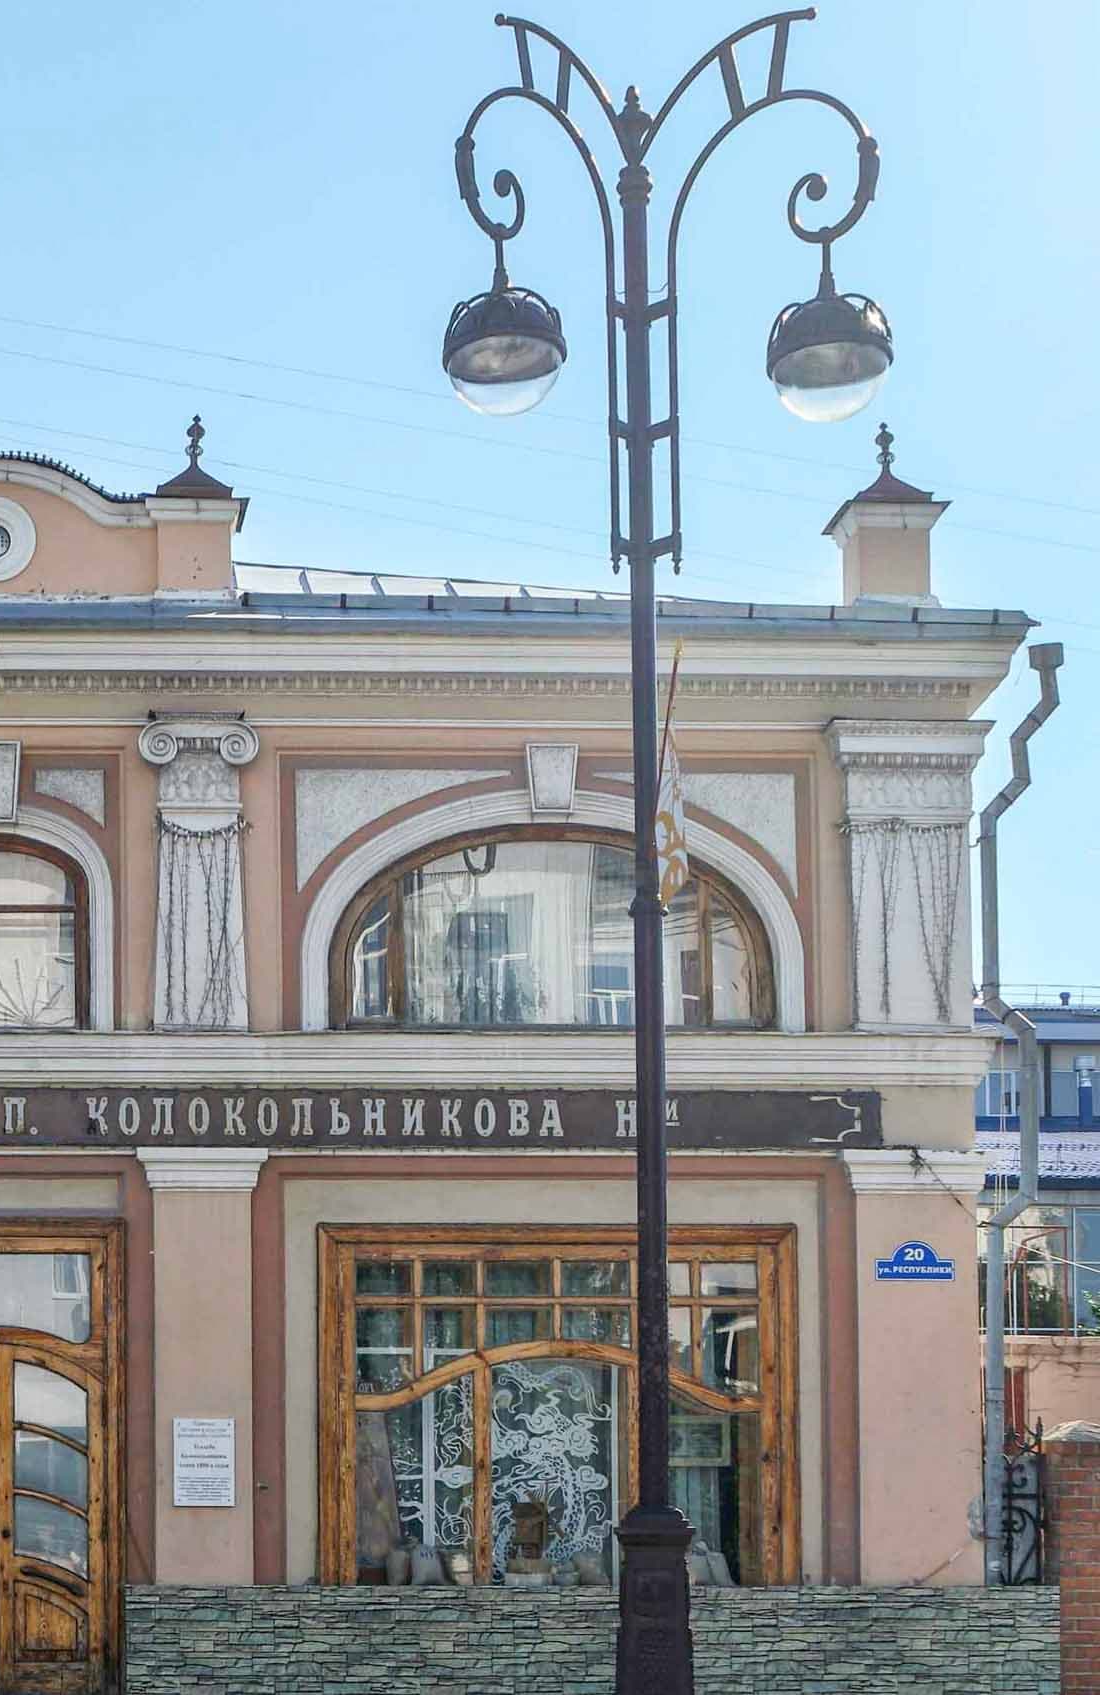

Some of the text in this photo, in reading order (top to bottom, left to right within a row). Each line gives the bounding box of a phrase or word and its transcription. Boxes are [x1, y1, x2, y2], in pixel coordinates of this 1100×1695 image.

[86, 1096, 564, 1136] КОЛОКОЛЬНИКОВА
[903, 1248, 925, 1261] 20
[878, 1265, 952, 1275] ул. РЕСПУБЛИКИ
